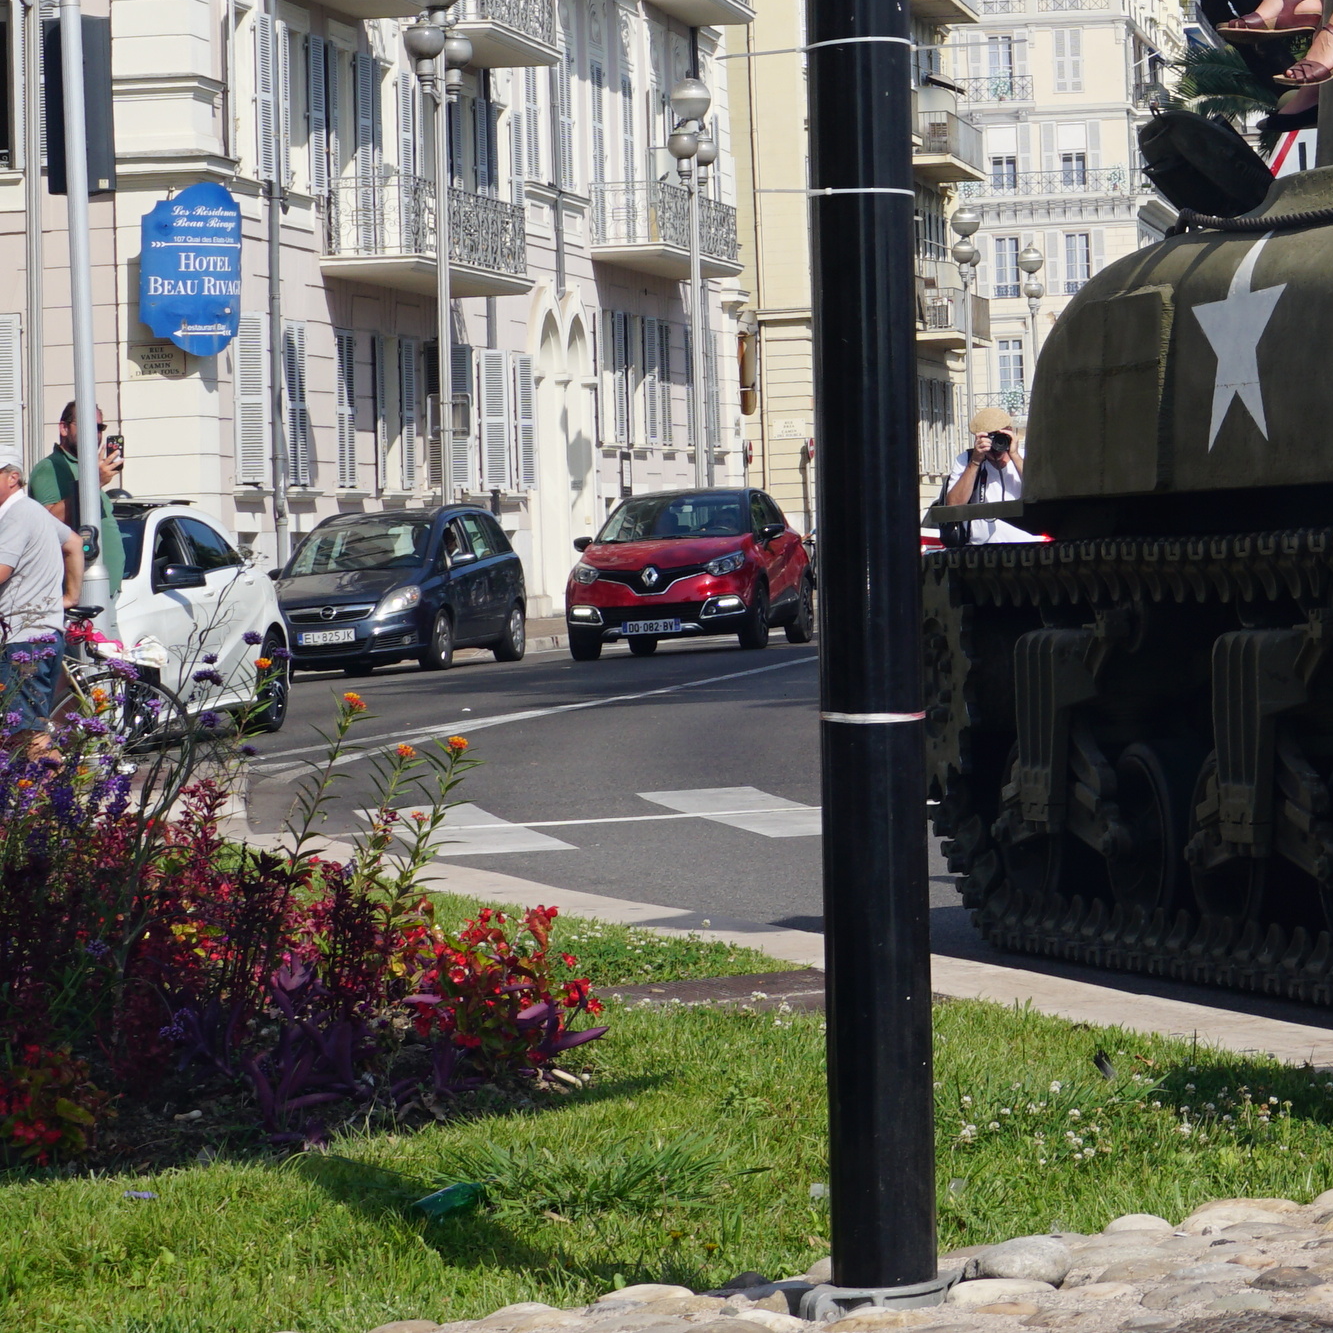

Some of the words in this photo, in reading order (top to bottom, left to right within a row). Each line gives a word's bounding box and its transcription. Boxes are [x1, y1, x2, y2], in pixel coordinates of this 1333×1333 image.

[172, 205, 189, 216] Les
[173, 217, 204, 228] Beau
[206, 217, 236, 232] Rivage
[178, 252, 232, 272] HOTEL
[147, 276, 199, 295] BEAU
